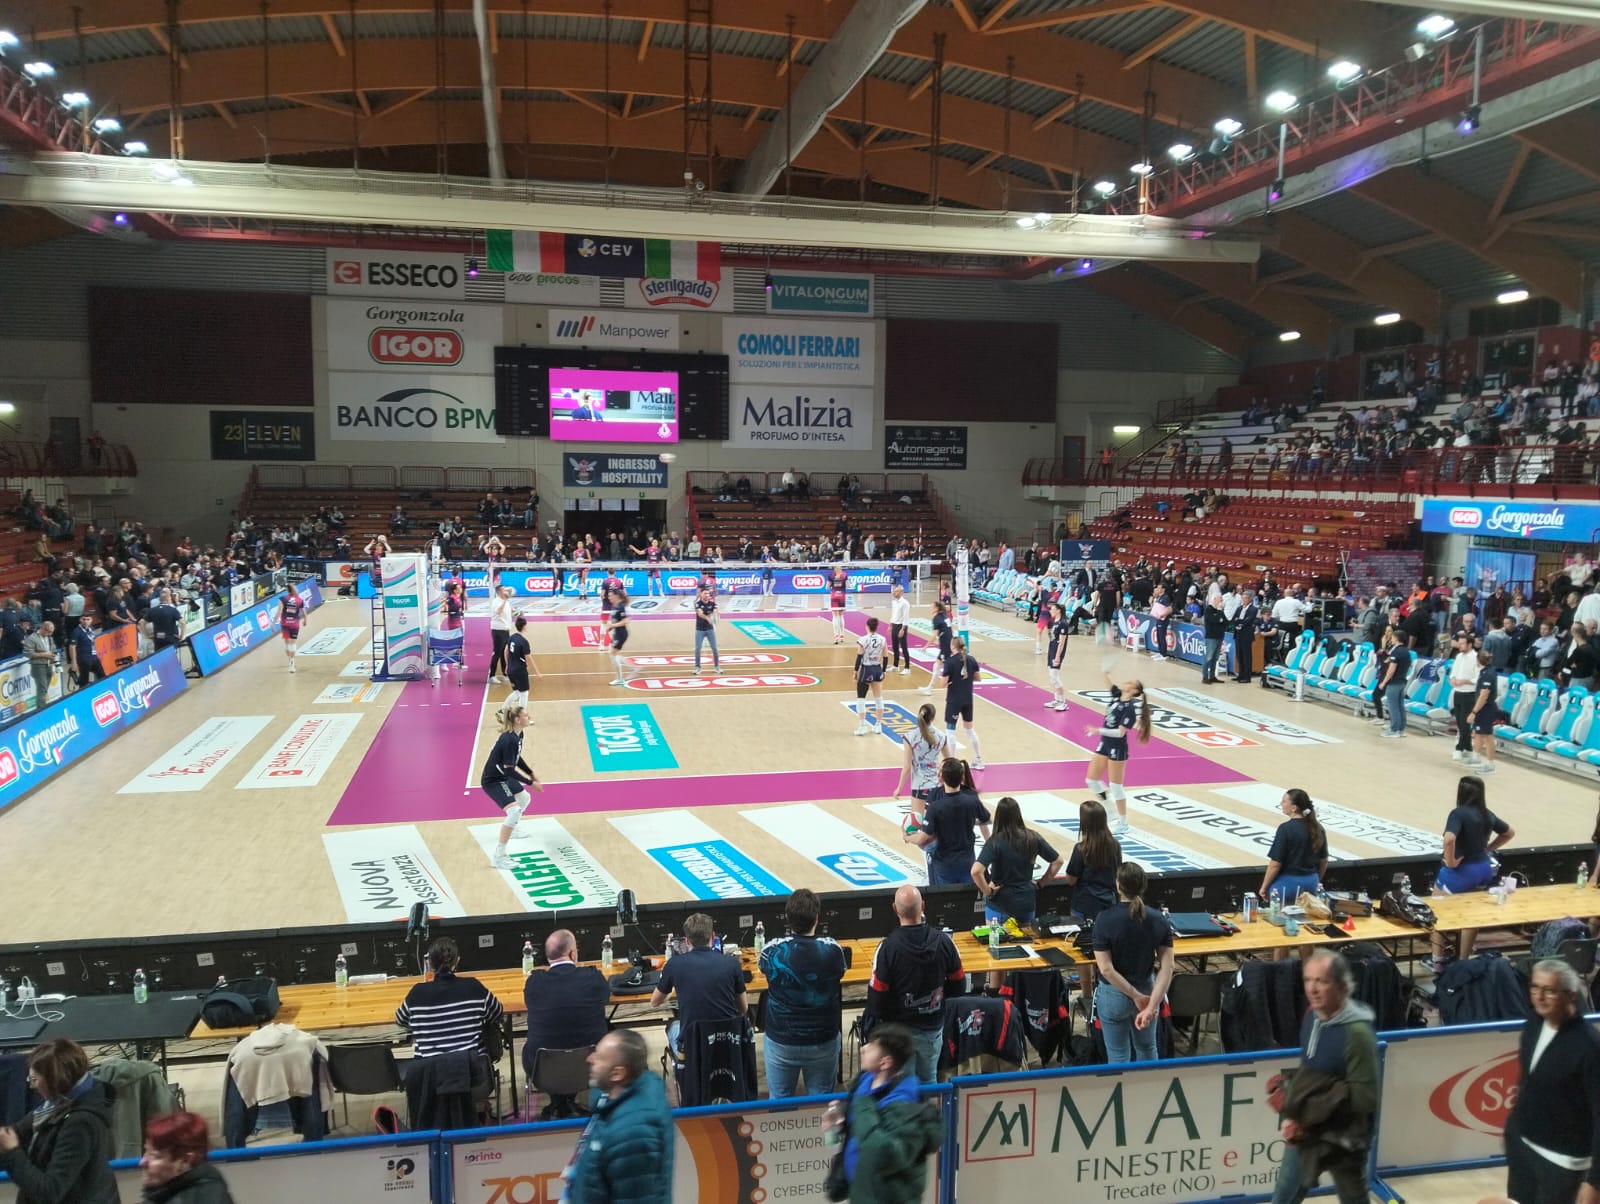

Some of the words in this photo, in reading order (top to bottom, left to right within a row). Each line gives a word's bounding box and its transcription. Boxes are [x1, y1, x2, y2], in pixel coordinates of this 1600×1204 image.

[600, 243, 633, 257] CEV
[368, 262, 458, 288] ESSECO
[536, 273, 580, 286] procos
[645, 278, 713, 299] sterilgarda
[775, 285, 867, 300] VITALONGUM
[366, 305, 464, 325] Gorgonzola
[600, 323, 668, 338] Manpower
[379, 335, 453, 358] IGOR
[738, 333, 796, 357] COMOLI
[798, 335, 860, 358] FERRARI
[738, 359, 781, 369] SOLUZIONI
[782, 360, 797, 369] PER
[798, 360, 860, 371] L'IMPIANTISTICA
[337, 405, 438, 429] BANCO
[445, 408, 498, 430] BPM
[742, 396, 854, 428] Malizia
[223, 425, 242, 440] 23
[248, 425, 301, 441] ELEVEN
[751, 431, 799, 441] PROFUMO
[802, 432, 845, 442] D'INTESA
[887, 441, 964, 456] Automagenta
[607, 458, 657, 470] INGRESSO
[601, 472, 663, 485] HOSPITALITY
[1453, 511, 1478, 523] IGOR
[1487, 505, 1565, 530] Gorgonzola
[671, 579, 695, 587] IGOR
[796, 578, 821, 587] IGOR
[509, 641, 515, 653] 5
[871, 638, 877, 649] 2
[95, 698, 117, 720] IGOR
[118, 664, 160, 713] Gorgonzola
[644, 675, 801, 689] IGOR
[1077, 689, 1212, 729] ESSO
[18, 708, 79, 774] Gorgonzola
[284, 719, 324, 750] CONSULTING
[1134, 792, 1276, 847] enalina
[558, 846, 595, 875] Solutions
[351, 858, 405, 910] NUOVA
[391, 854, 443, 905] Assistenza
[509, 850, 585, 909] CALEFFI
[1481, 1077, 1519, 1111] Sa
[769, 1137, 826, 1152] NETWOR
[775, 1159, 832, 1175] TELEFON
[1077, 1147, 1212, 1183] FINESTRE
[1223, 1149, 1238, 1168] e
[1250, 1139, 1287, 1165] PO
[1104, 1182, 1166, 1200] Trecate
[1172, 1174, 1216, 1195] (NO)
[1241, 1167, 1281, 1186] maff
